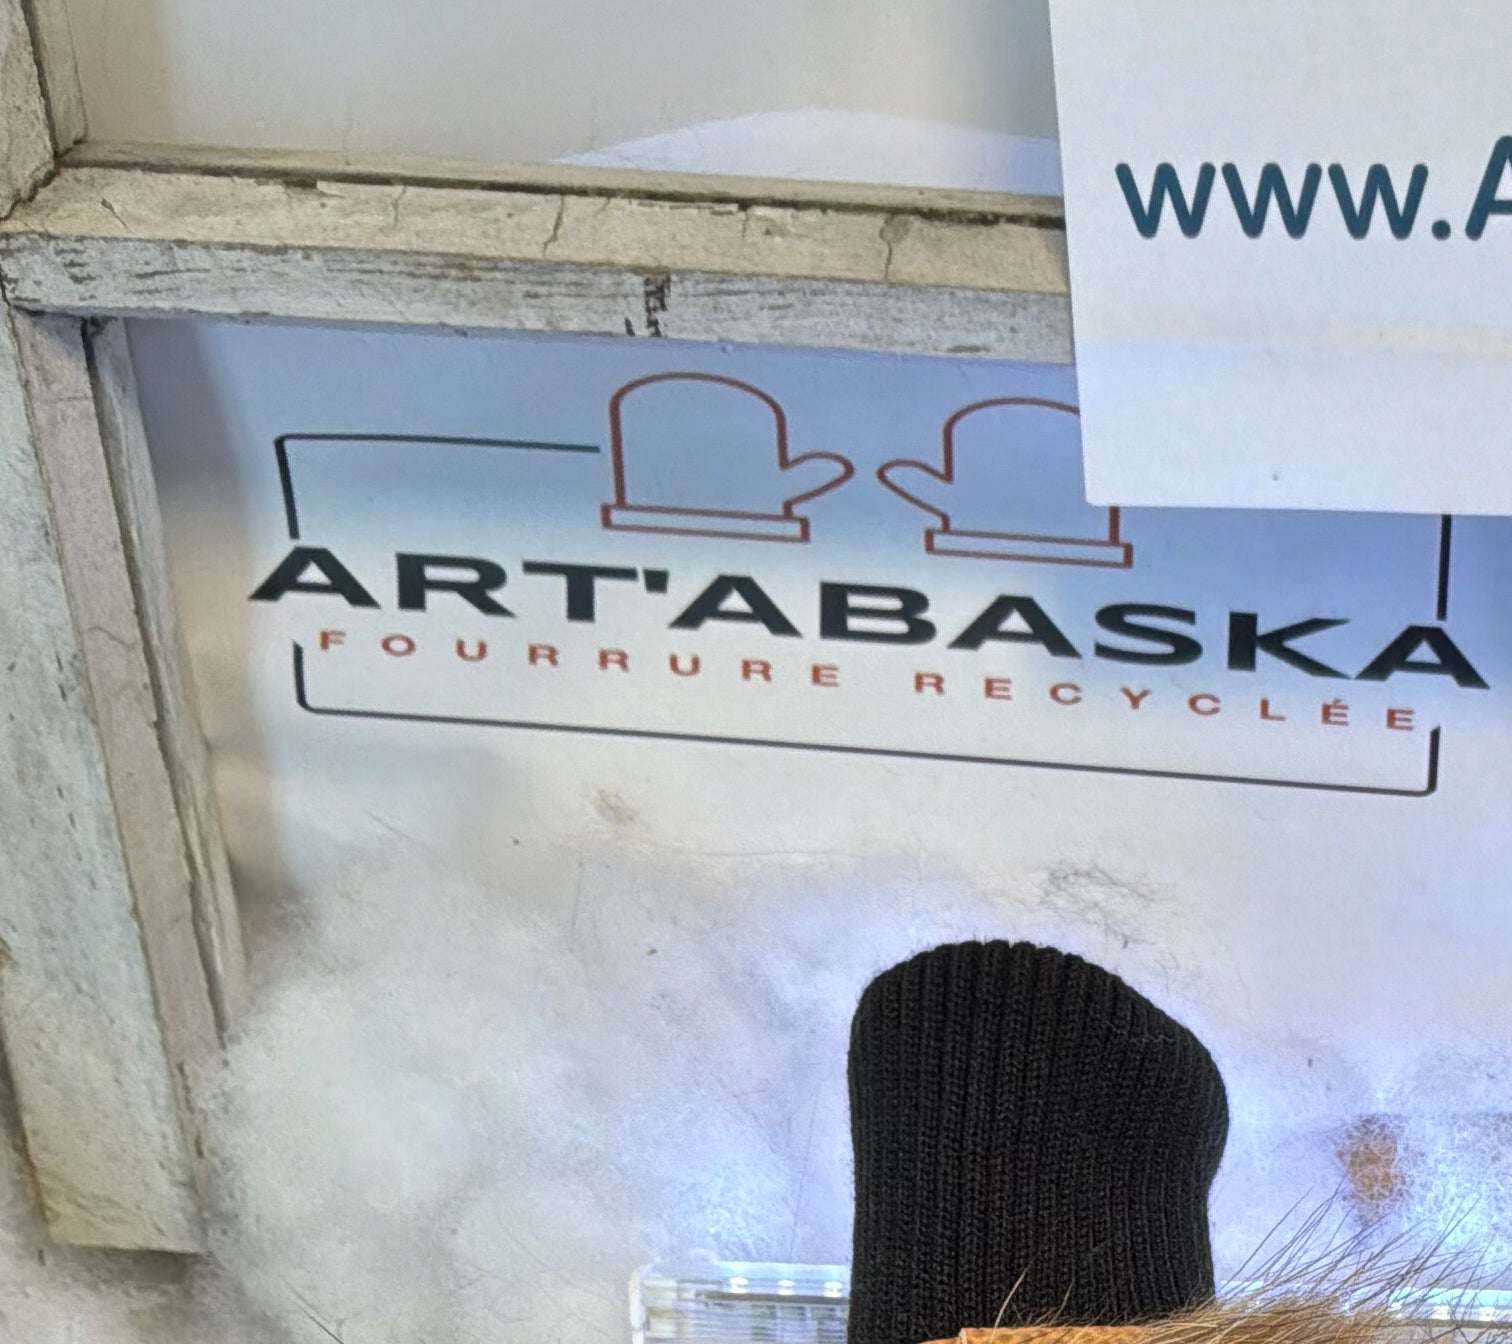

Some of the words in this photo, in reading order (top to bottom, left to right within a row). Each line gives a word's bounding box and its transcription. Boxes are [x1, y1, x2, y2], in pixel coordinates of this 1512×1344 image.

[247, 545, 1490, 690] ART'ABASKA
[317, 630, 841, 689] FOURRURE
[911, 671, 1417, 732] RECYCLÉE
